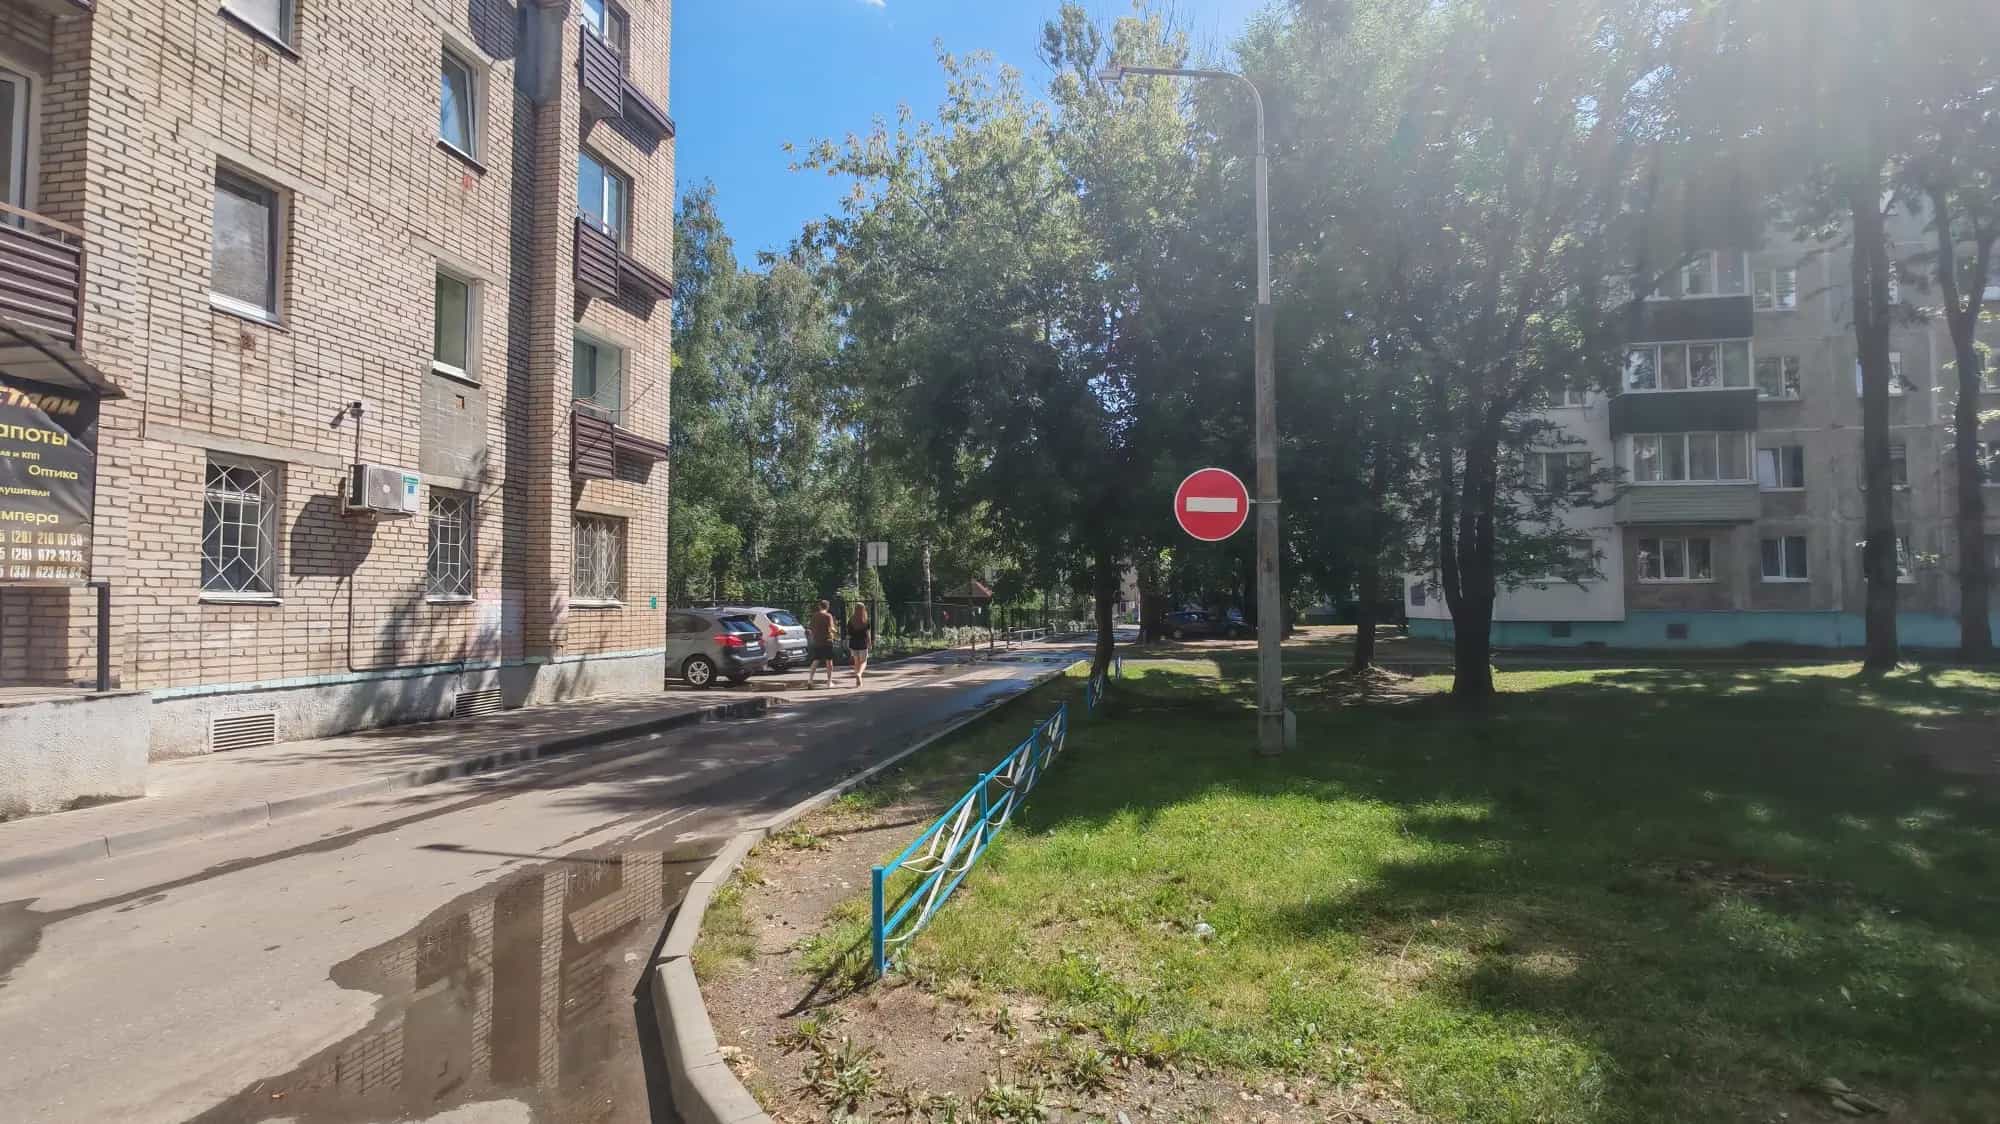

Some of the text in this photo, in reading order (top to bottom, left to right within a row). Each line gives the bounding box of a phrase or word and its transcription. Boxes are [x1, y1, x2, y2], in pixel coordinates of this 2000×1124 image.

[22, 451, 40, 460] КПП
[28, 464, 78, 480] Оптика
[0, 510, 59, 526] мпера
